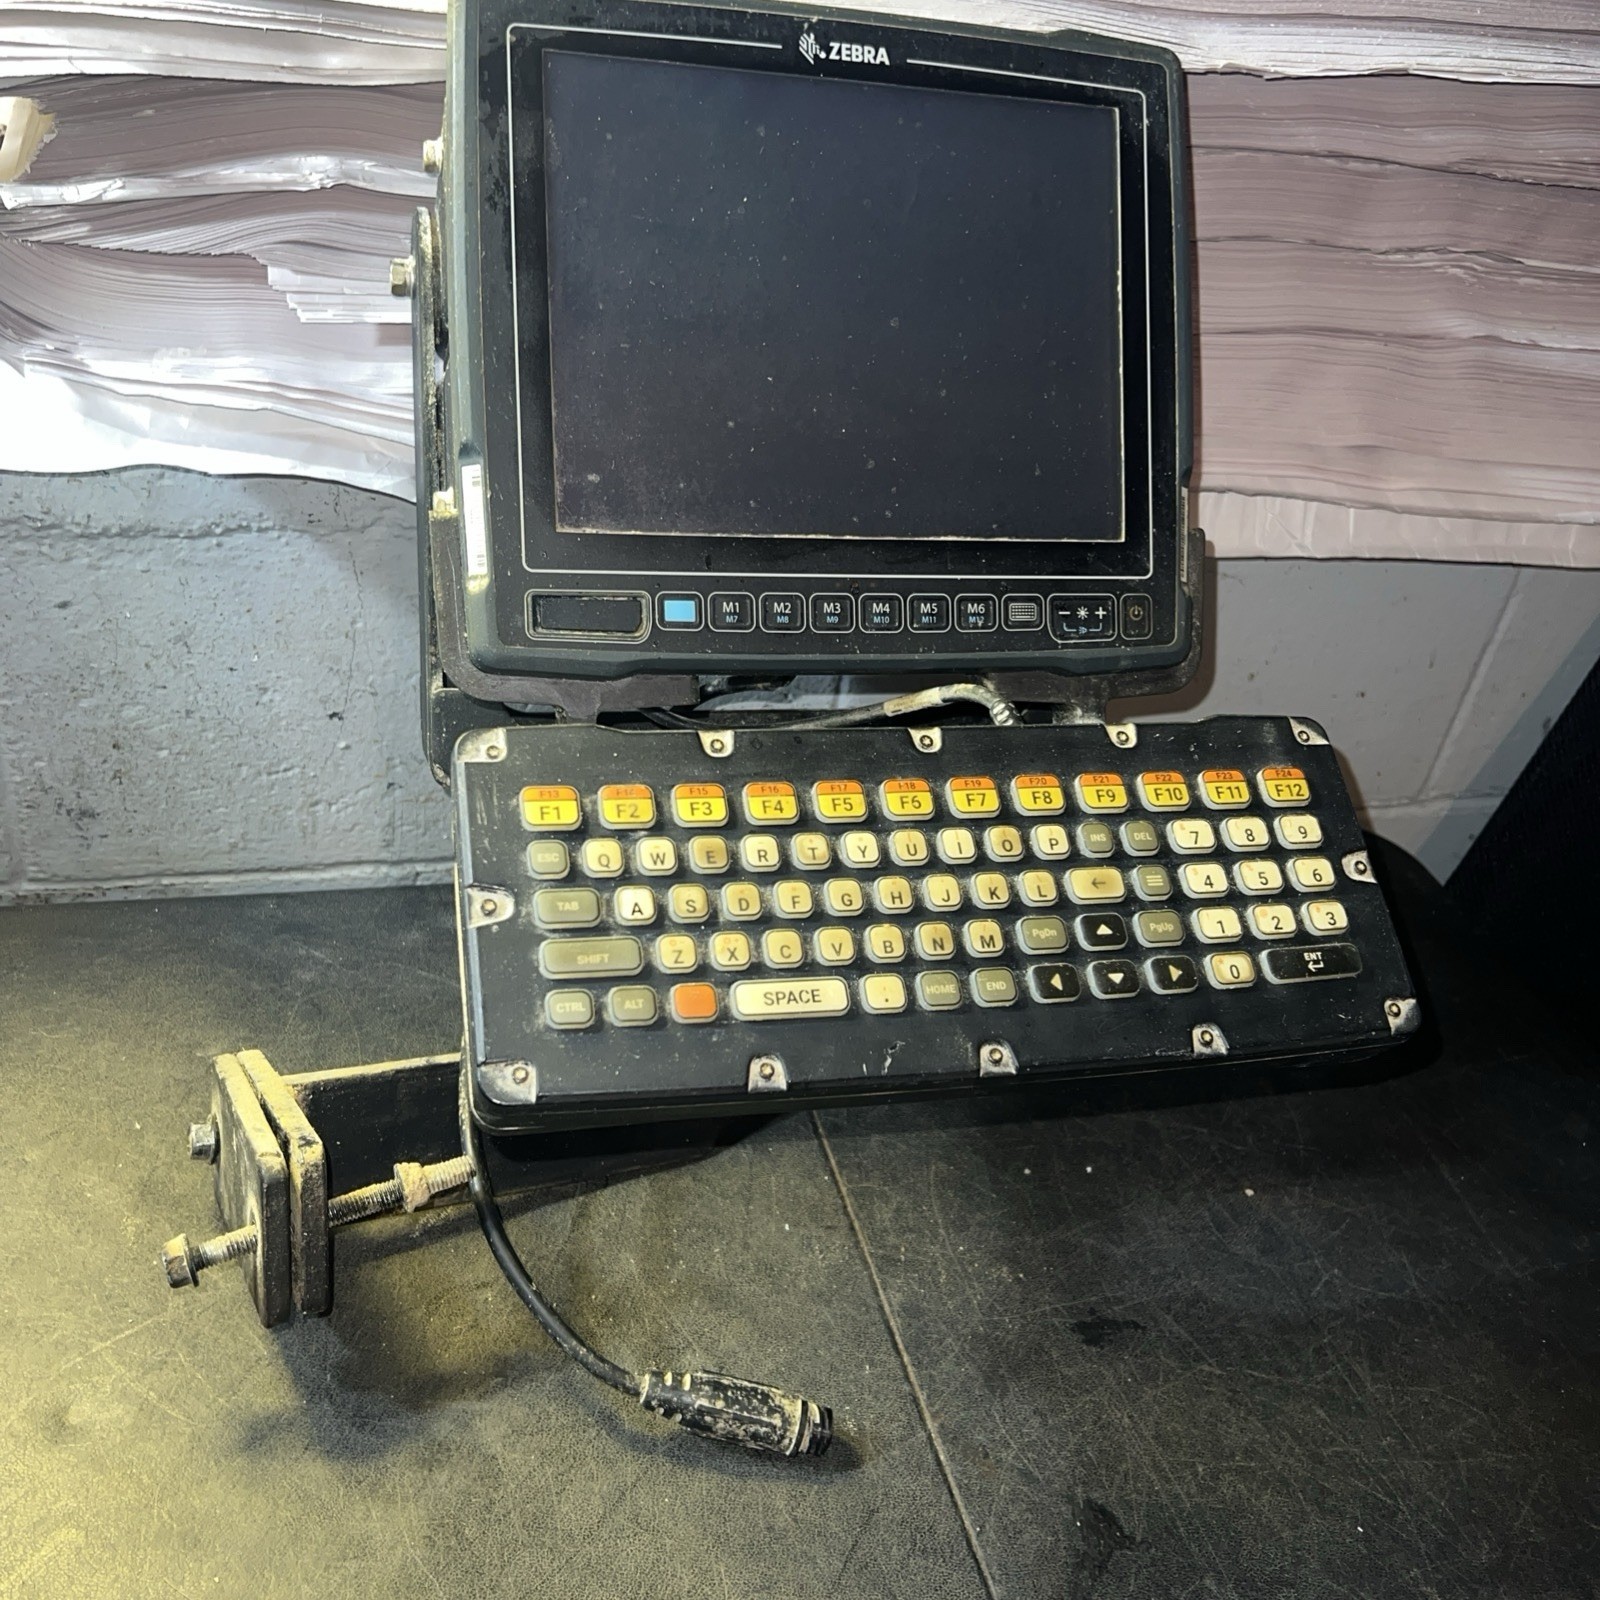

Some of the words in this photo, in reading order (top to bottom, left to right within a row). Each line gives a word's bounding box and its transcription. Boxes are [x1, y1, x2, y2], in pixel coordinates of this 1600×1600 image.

[829, 41, 890, 66] ZEBRA
[722, 601, 740, 613] M1
[773, 602, 792, 614] M2
[823, 603, 841, 614] M3
[872, 603, 890, 614] M4
[920, 603, 938, 614] M5
[967, 603, 985, 614] M6
[726, 615, 738, 623] M7
[777, 616, 789, 624] M8
[826, 616, 839, 624] M9
[873, 616, 890, 624] M10
[921, 616, 937, 624] M11
[1092, 775, 1110, 783] F21
[1155, 774, 1172, 782] F22
[1275, 770, 1292, 778] F24
[1029, 777, 1047, 785] F20
[539, 790, 559, 798] F13
[689, 787, 708, 795] F15
[760, 785, 779, 794] F16
[831, 784, 848, 792] F17
[1154, 787, 1183, 801] F10
[1216, 786, 1243, 800] F11
[1274, 784, 1305, 797] F12
[900, 796, 922, 809] F6
[966, 793, 986, 807] F7
[1032, 791, 1053, 805] F8
[1096, 789, 1116, 803] F9
[616, 804, 640, 818] F2
[689, 802, 713, 816] F3
[762, 800, 784, 814] F4
[832, 798, 853, 812] F5
[540, 806, 561, 820] F1
[1090, 833, 1106, 842] INS
[1133, 832, 1152, 841] DEL
[1189, 831, 1199, 845] 7
[1244, 828, 1255, 842] 8
[1297, 825, 1308, 839] 9
[907, 843, 917, 856] U
[957, 842, 963, 854] I
[1048, 838, 1059, 851] P
[537, 852, 560, 863] ESC
[707, 851, 717, 864] E
[758, 850, 768, 862] R
[808, 847, 818, 860] T
[857, 845, 868, 858] Y
[598, 854, 610, 868] Q
[650, 852, 667, 866] W
[1204, 875, 1214, 888] 4
[1258, 871, 1269, 886] 5
[1312, 868, 1323, 882] 6
[941, 889, 950, 903] J
[988, 886, 1000, 900] K
[1037, 884, 1048, 897] L
[738, 898, 749, 911] D
[791, 895, 801, 909] F
[841, 893, 852, 907] G
[890, 891, 903, 905] H
[557, 901, 579, 912] TAB
[631, 902, 643, 916] A
[686, 900, 697, 913] S
[1271, 916, 1283, 930] 2
[1325, 912, 1337, 926] 3
[1150, 922, 1175, 933] PgUp
[1217, 920, 1226, 934] 1
[1032, 928, 1057, 940] PgDn
[882, 940, 894, 954] B
[932, 937, 945, 951] N
[979, 934, 996, 949] M
[727, 947, 739, 962] X
[780, 945, 791, 959] C
[831, 942, 843, 957] V
[576, 953, 609, 965] SHIFT
[673, 950, 684, 964] Z
[1304, 952, 1322, 961] ENT
[926, 984, 956, 994] HOME
[986, 981, 1006, 991] END
[763, 989, 823, 1006] SPACE
[556, 1002, 586, 1013] CTRL
[623, 999, 645, 1010] ALT
